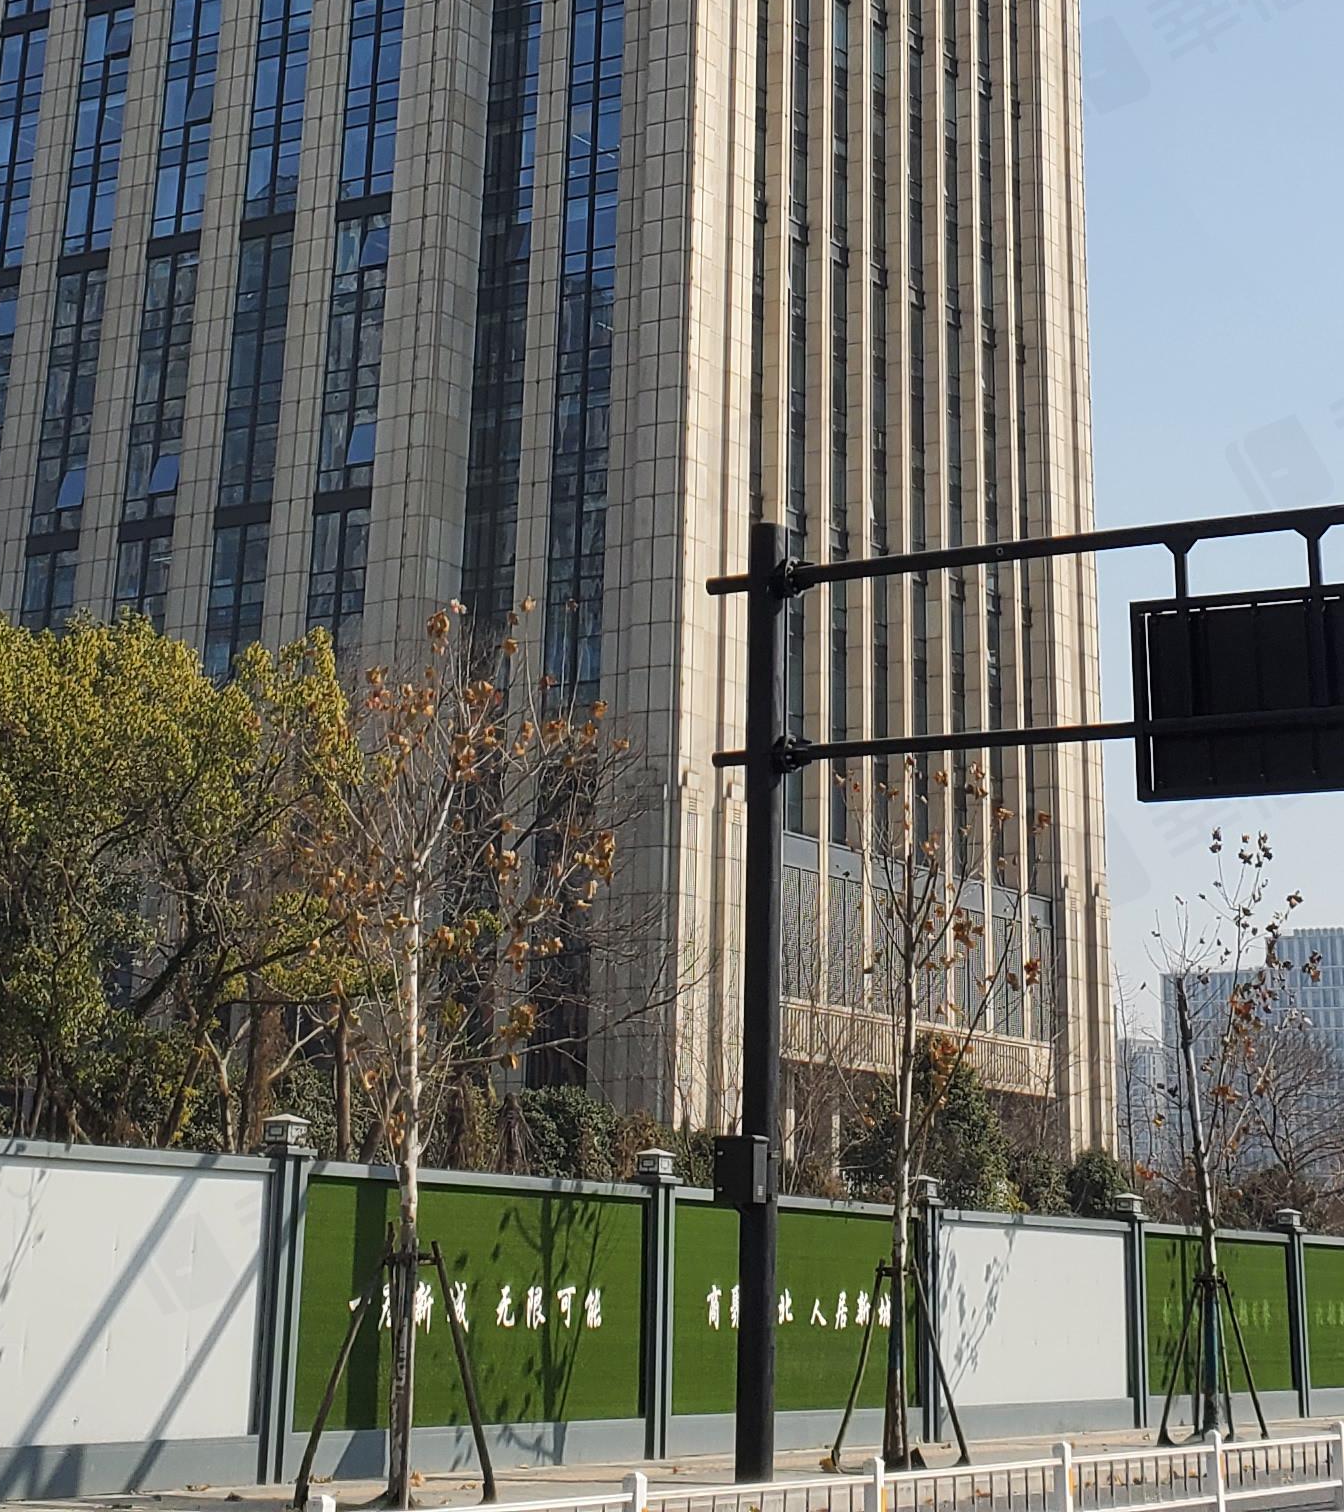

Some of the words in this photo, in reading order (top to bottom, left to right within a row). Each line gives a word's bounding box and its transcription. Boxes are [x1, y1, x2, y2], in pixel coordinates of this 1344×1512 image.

[496, 1285, 603, 1330] 无限可能
[810, 1290, 891, 1330] 人居新城
